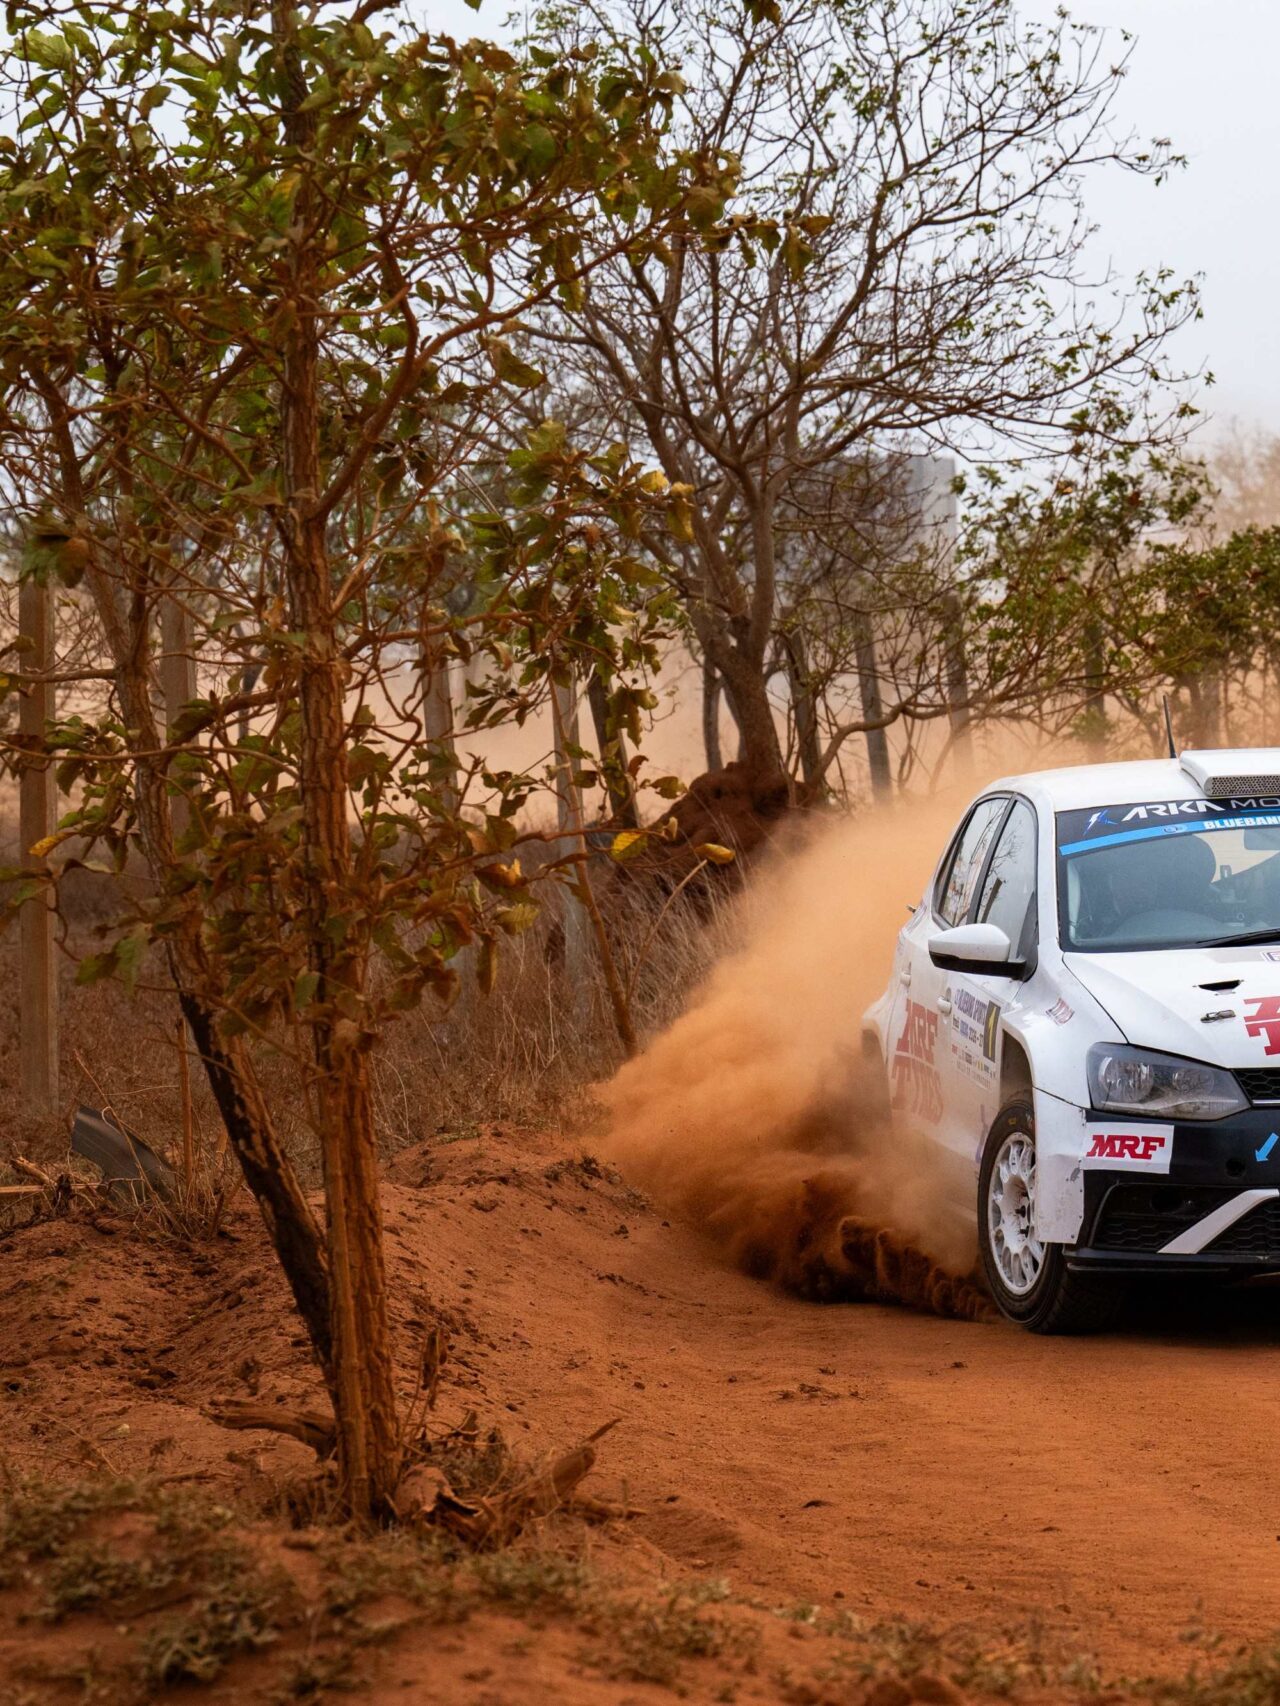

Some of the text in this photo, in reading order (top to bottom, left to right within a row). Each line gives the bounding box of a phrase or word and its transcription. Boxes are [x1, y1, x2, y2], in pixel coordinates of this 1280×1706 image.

[1121, 800, 1226, 822] ARKA
[896, 998, 939, 1066] MRF
[1086, 1134, 1166, 1160] MRF
